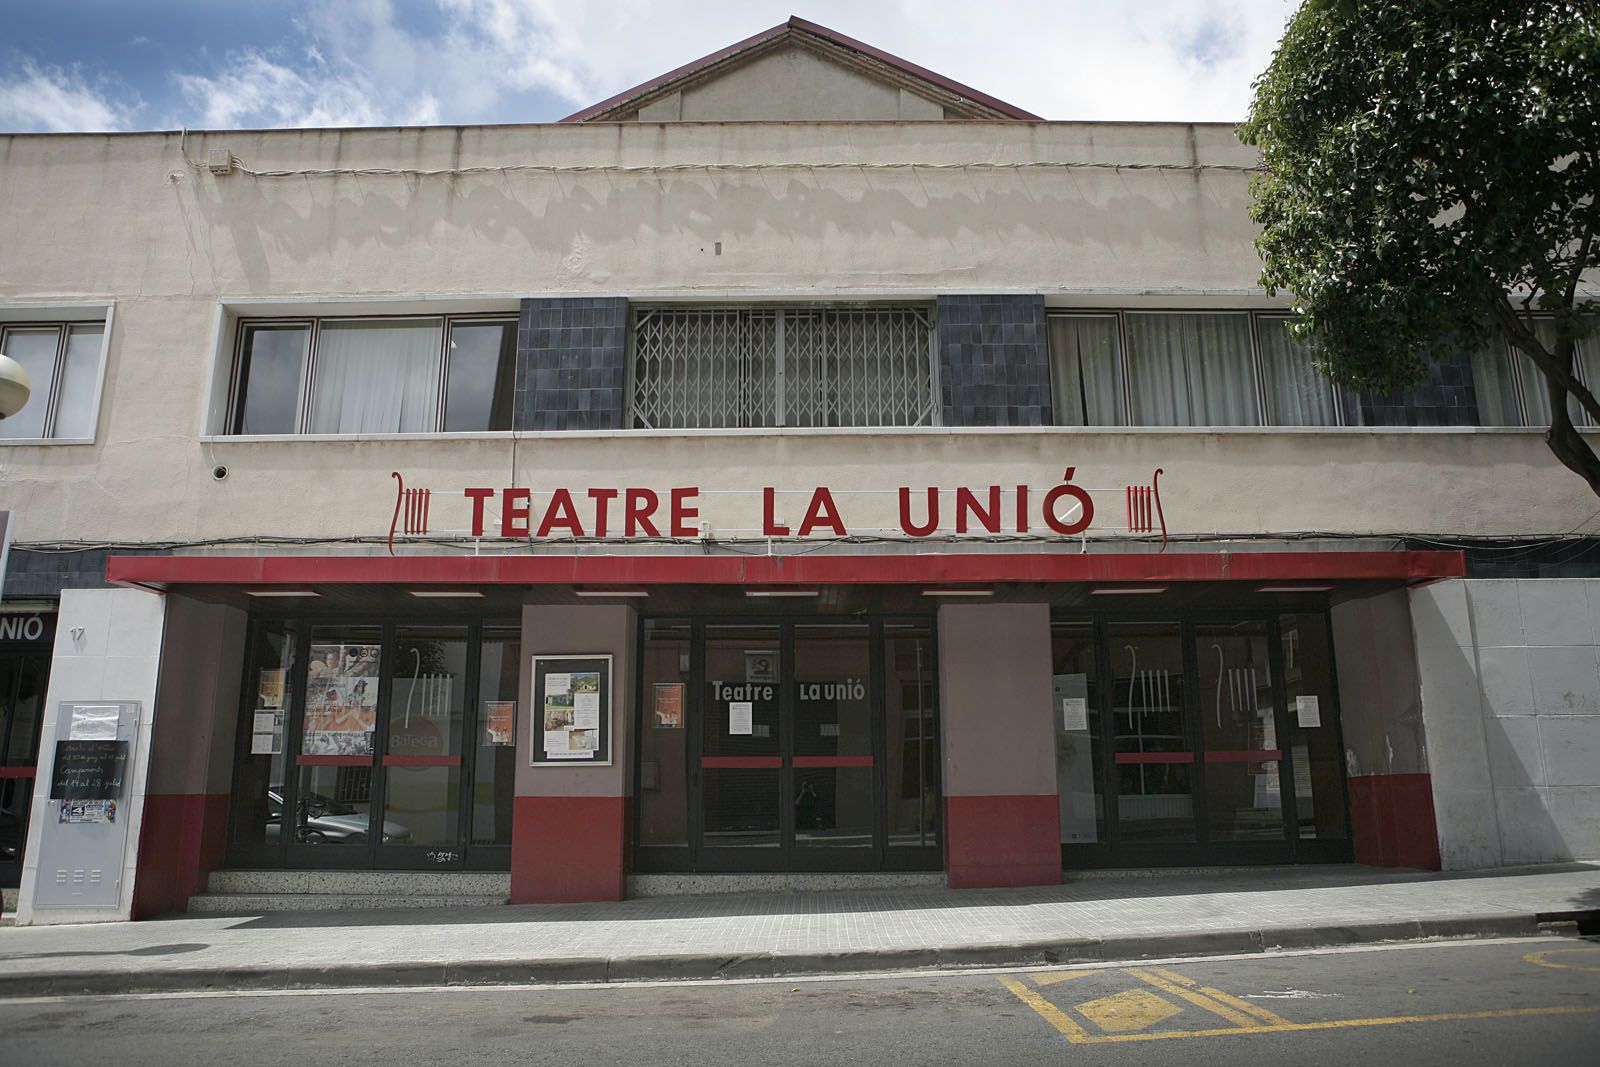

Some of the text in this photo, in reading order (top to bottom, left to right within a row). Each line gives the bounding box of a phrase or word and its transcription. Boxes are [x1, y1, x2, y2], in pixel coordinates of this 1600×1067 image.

[465, 468, 1093, 538] TEATRE LA UNIÓ
[70, 627, 85, 641] 17
[712, 680, 773, 701] Teatre
[824, 678, 865, 700] unió
